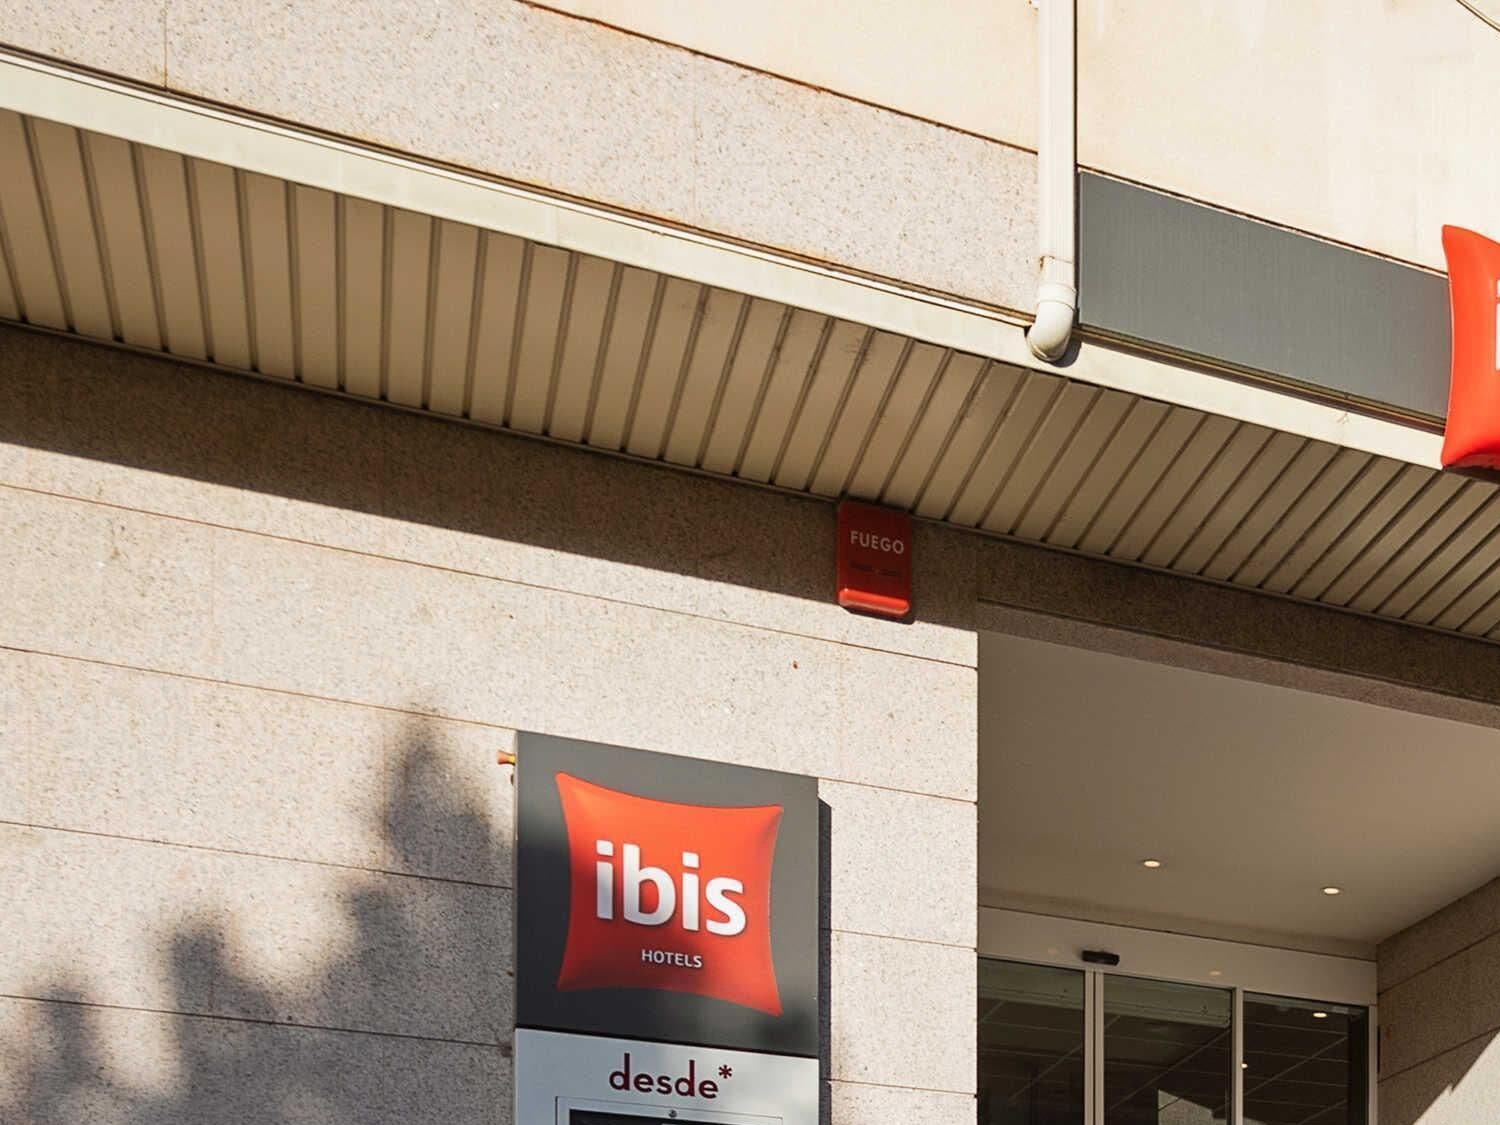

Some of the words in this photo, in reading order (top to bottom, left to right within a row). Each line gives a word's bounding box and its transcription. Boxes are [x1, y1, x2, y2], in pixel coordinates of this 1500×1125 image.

[849, 530, 905, 555] FUEGO
[595, 838, 748, 937] ibis
[641, 949, 703, 969] HOTELS
